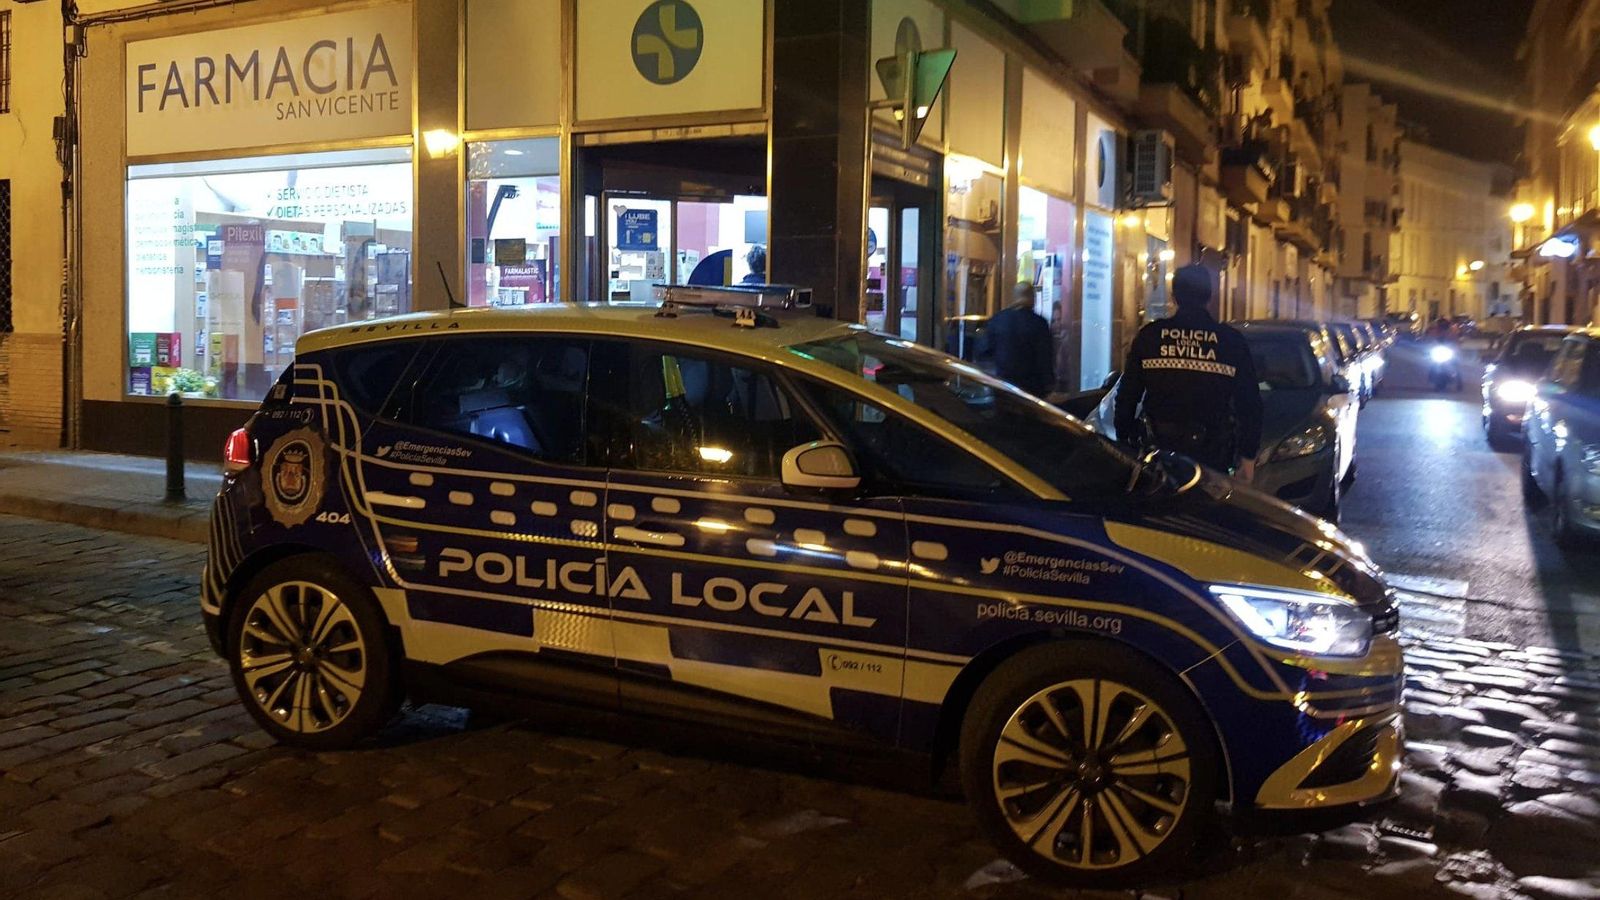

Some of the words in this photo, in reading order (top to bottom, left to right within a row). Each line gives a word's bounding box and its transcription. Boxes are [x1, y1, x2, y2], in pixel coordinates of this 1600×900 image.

[137, 33, 399, 113] FARMACIA
[276, 99, 311, 121] SAN
[317, 91, 399, 116] VICENTE
[227, 226, 262, 241] Pilexil
[504, 267, 539, 275] FARMALASTIC
[350, 321, 460, 334] SEVILLA
[1161, 328, 1218, 344] POLICIA
[1176, 339, 1201, 348] LOCAL
[1160, 344, 1217, 361] SEVILLA
[394, 440, 473, 458] @EmergenciasSev
[315, 511, 351, 525] 404
[1004, 550, 1126, 575] @EmergenciasSev
[439, 547, 651, 600] POLICÍA
[671, 572, 878, 628] LOCAL
[977, 602, 1123, 635] policia.sevilla.org
[867, 663, 883, 674] 112
